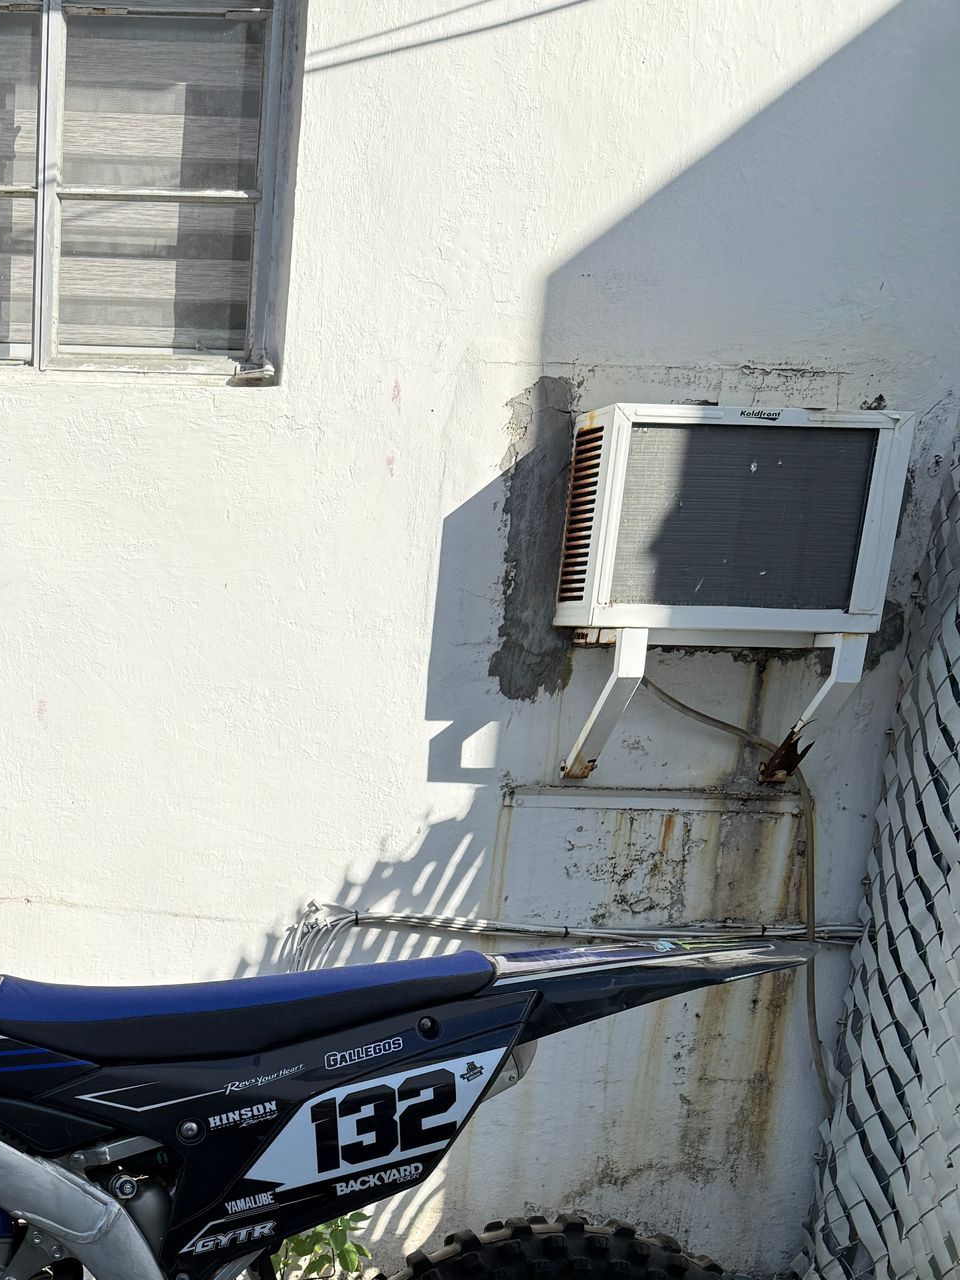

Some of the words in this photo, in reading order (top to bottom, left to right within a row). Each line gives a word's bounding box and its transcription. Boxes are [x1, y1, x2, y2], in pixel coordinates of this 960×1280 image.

[208, 1100, 277, 1127] HINSON
[310, 1068, 457, 1174] 132
[336, 1162, 423, 1196] BACKYARD
[224, 1191, 275, 1214] YAMALUBE
[193, 1220, 277, 1255] GYTR
